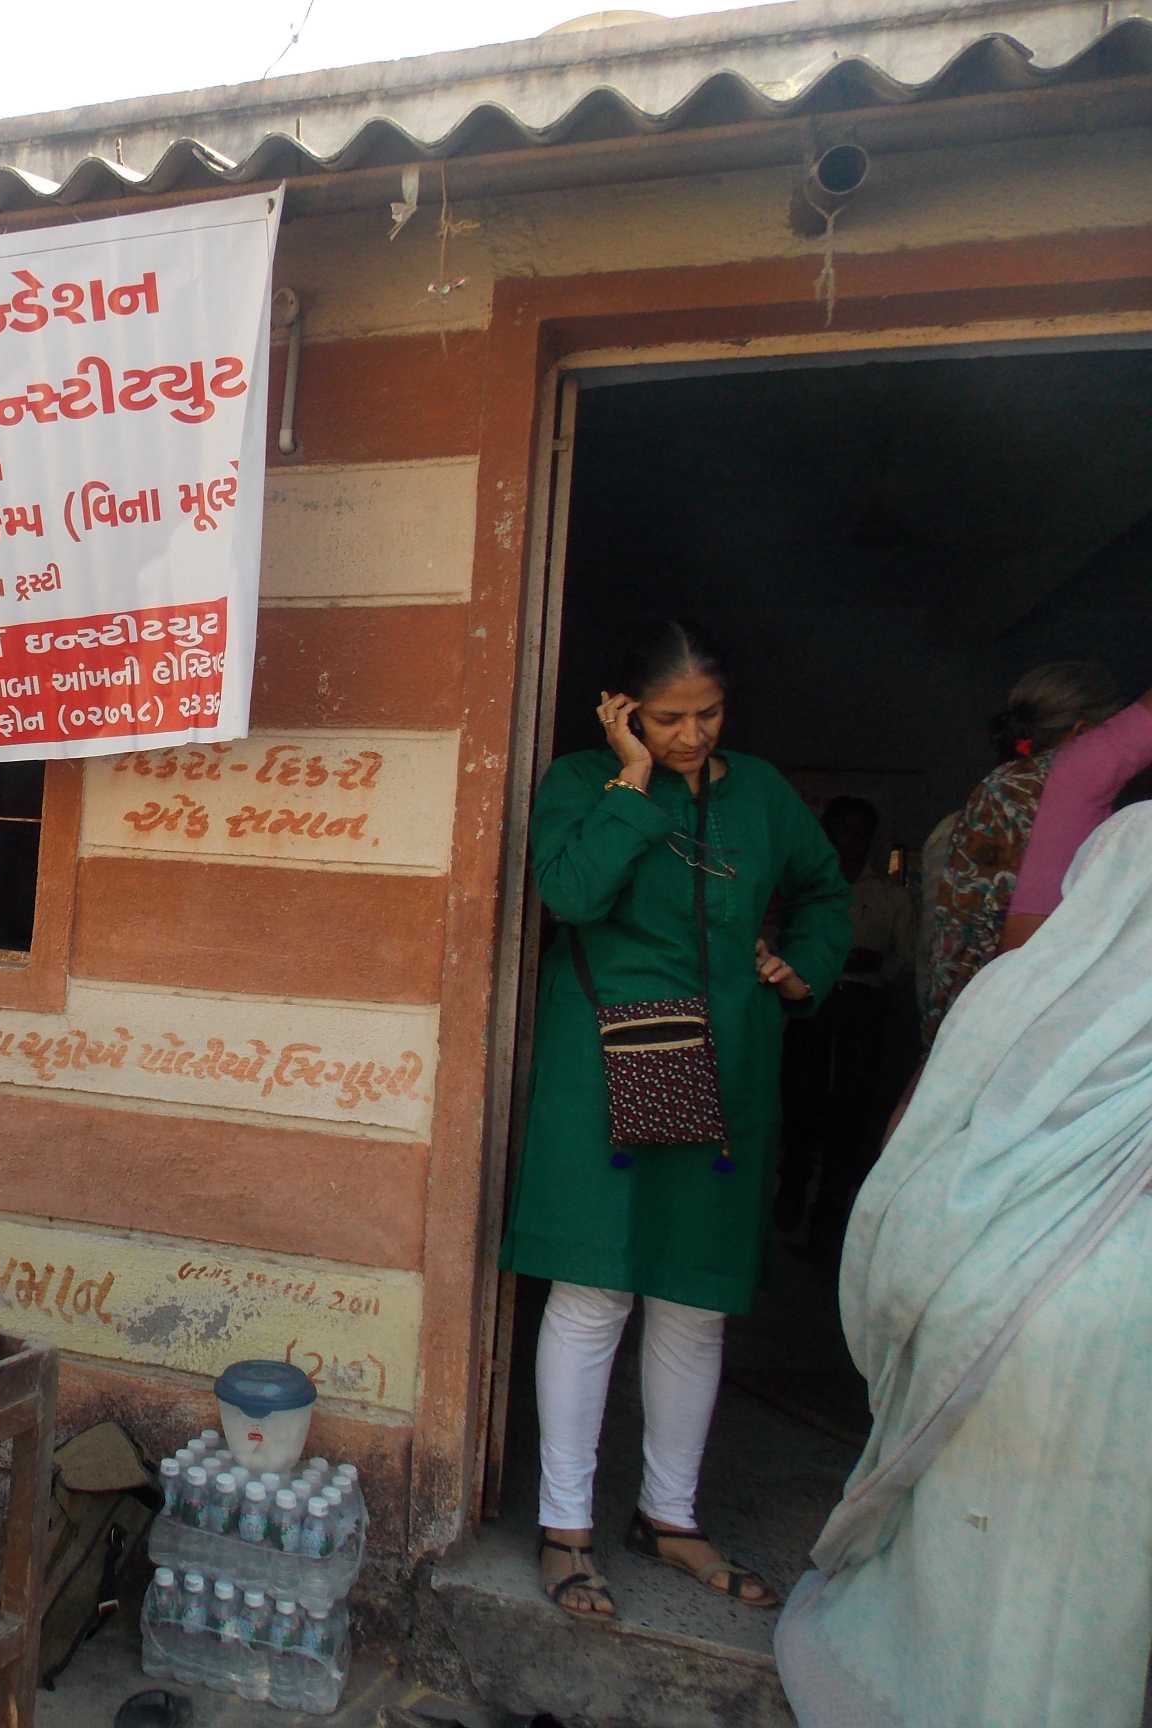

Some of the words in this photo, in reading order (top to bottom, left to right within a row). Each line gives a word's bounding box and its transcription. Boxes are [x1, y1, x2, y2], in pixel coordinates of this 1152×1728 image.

[63, 480, 161, 542] (વિના
[15, 562, 62, 601] ટ્રસ્ટી
[52, 656, 140, 694] આંખની
